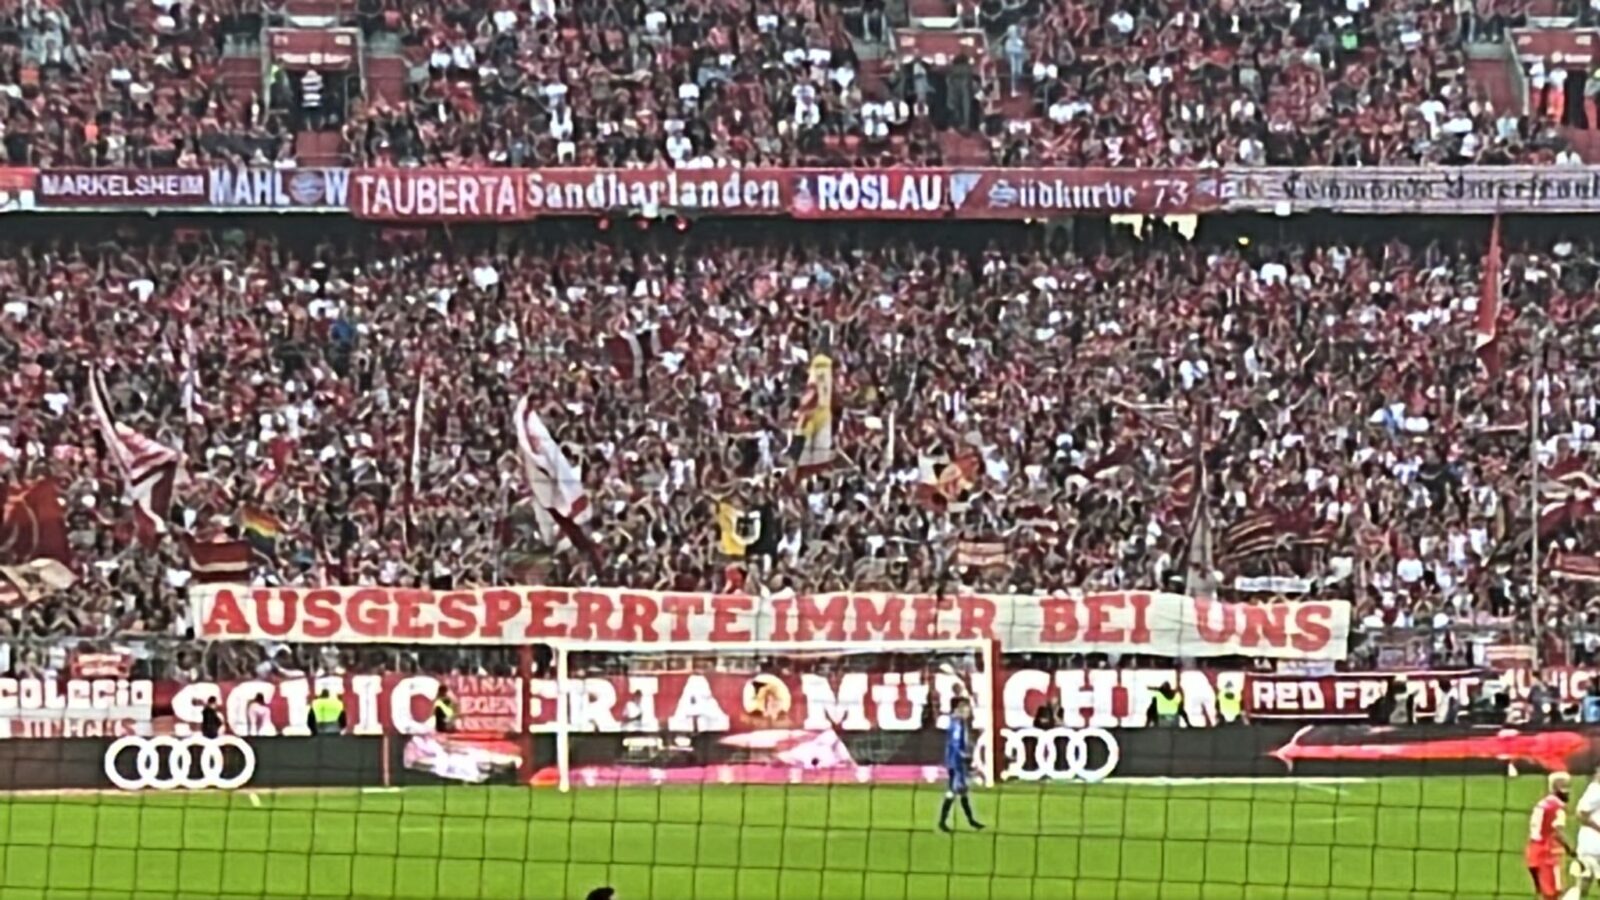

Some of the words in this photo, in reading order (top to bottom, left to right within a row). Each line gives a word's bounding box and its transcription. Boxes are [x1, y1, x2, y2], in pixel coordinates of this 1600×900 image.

[41, 174, 204, 196] MARKELSHEIM
[526, 172, 779, 210] Sandharlanden
[818, 172, 941, 210] RÖSLAU
[988, 179, 1136, 208] Südkurve
[203, 588, 753, 642] AUSGESPERRTE
[771, 594, 997, 641] IMMER
[1039, 594, 1152, 645] BEI
[1193, 601, 1332, 652] UNS
